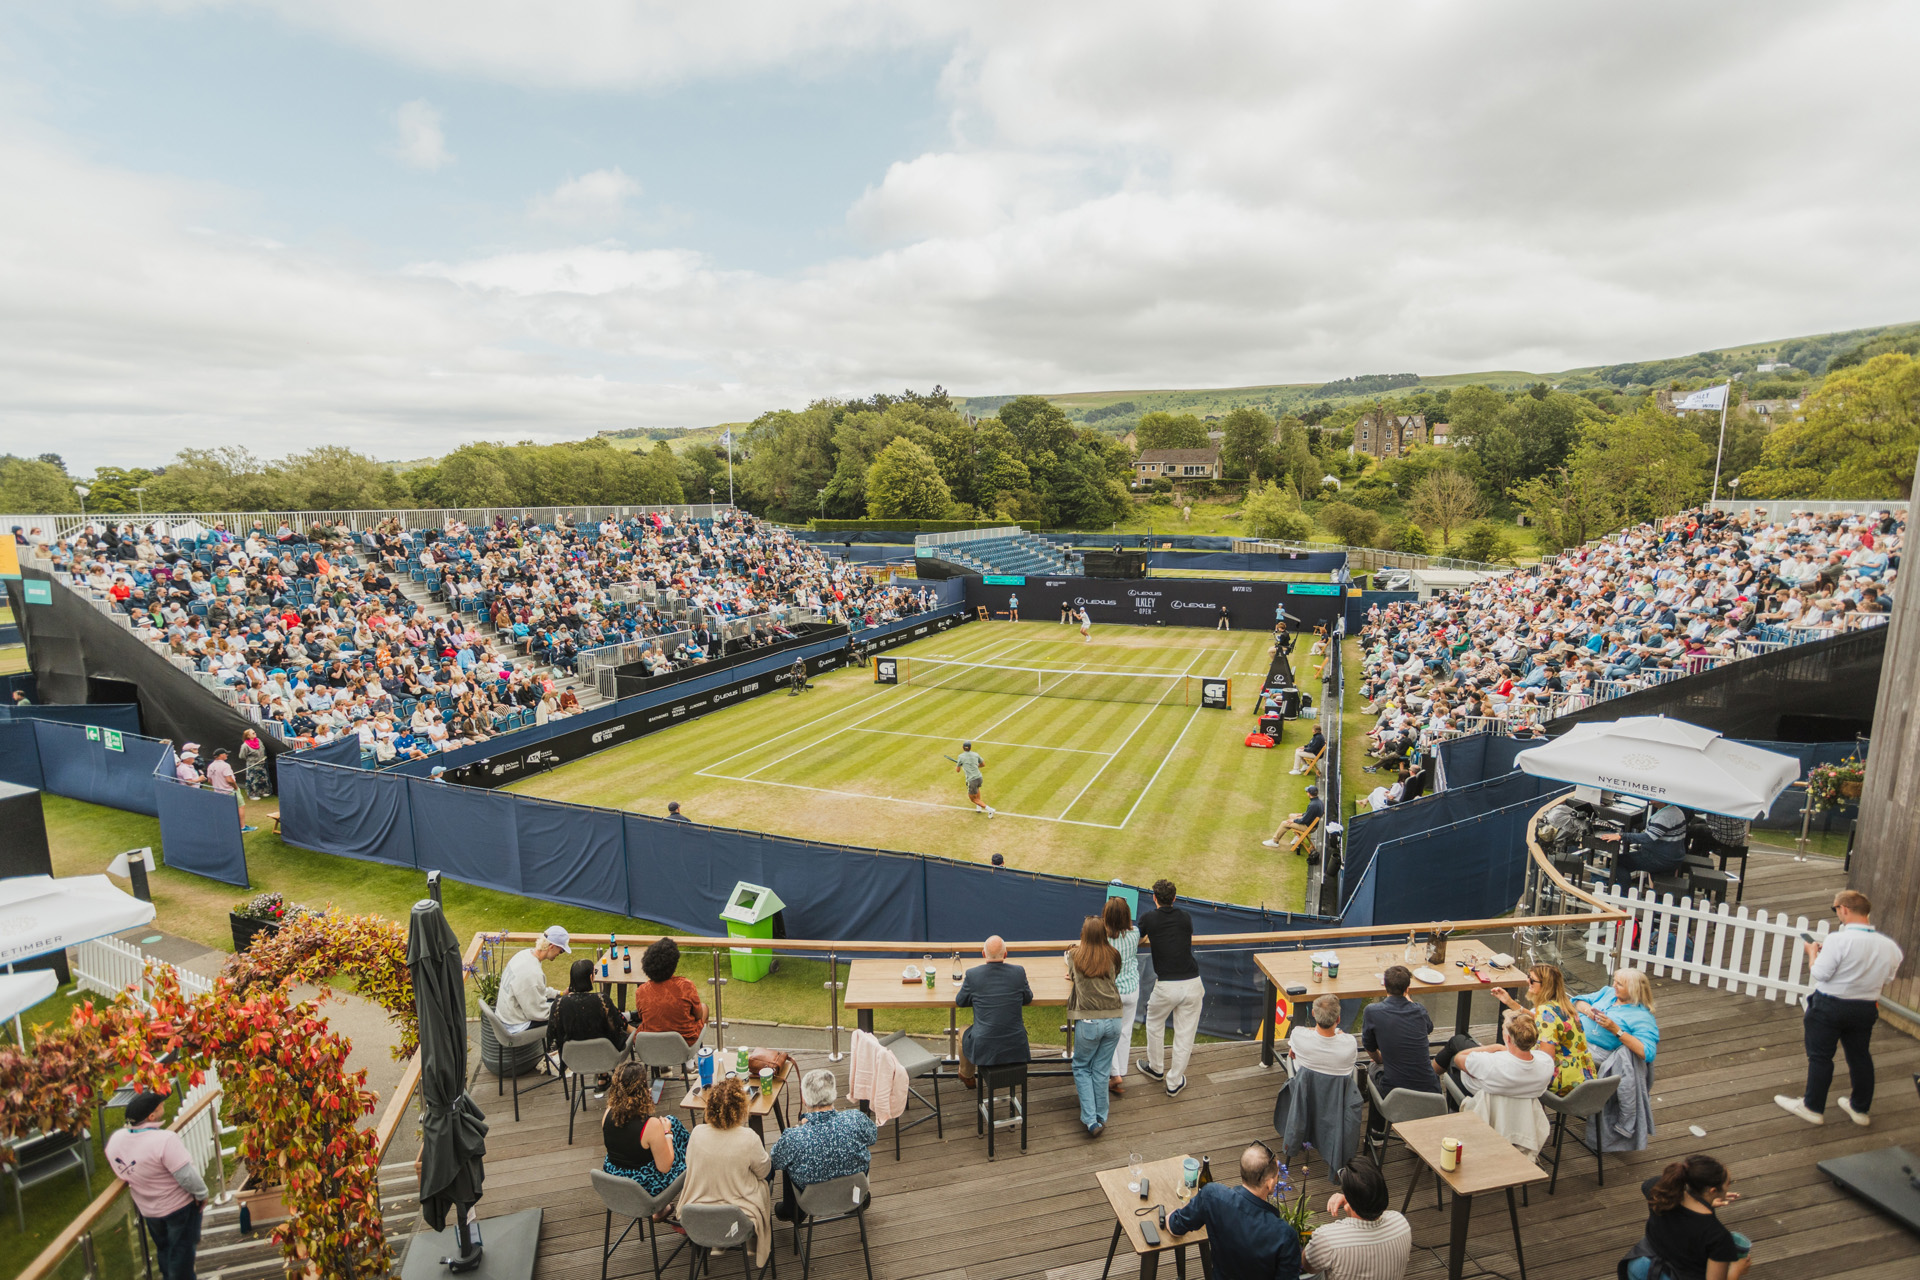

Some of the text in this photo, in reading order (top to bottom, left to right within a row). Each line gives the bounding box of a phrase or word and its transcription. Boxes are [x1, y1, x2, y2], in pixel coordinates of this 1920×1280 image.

[1136, 598, 1156, 608] ILKLEY
[720, 690, 738, 700] LEXUS
[602, 724, 626, 737] CHALLENGER
[603, 732, 612, 740] TOUR
[1598, 775, 1666, 794] NYETIMBER
